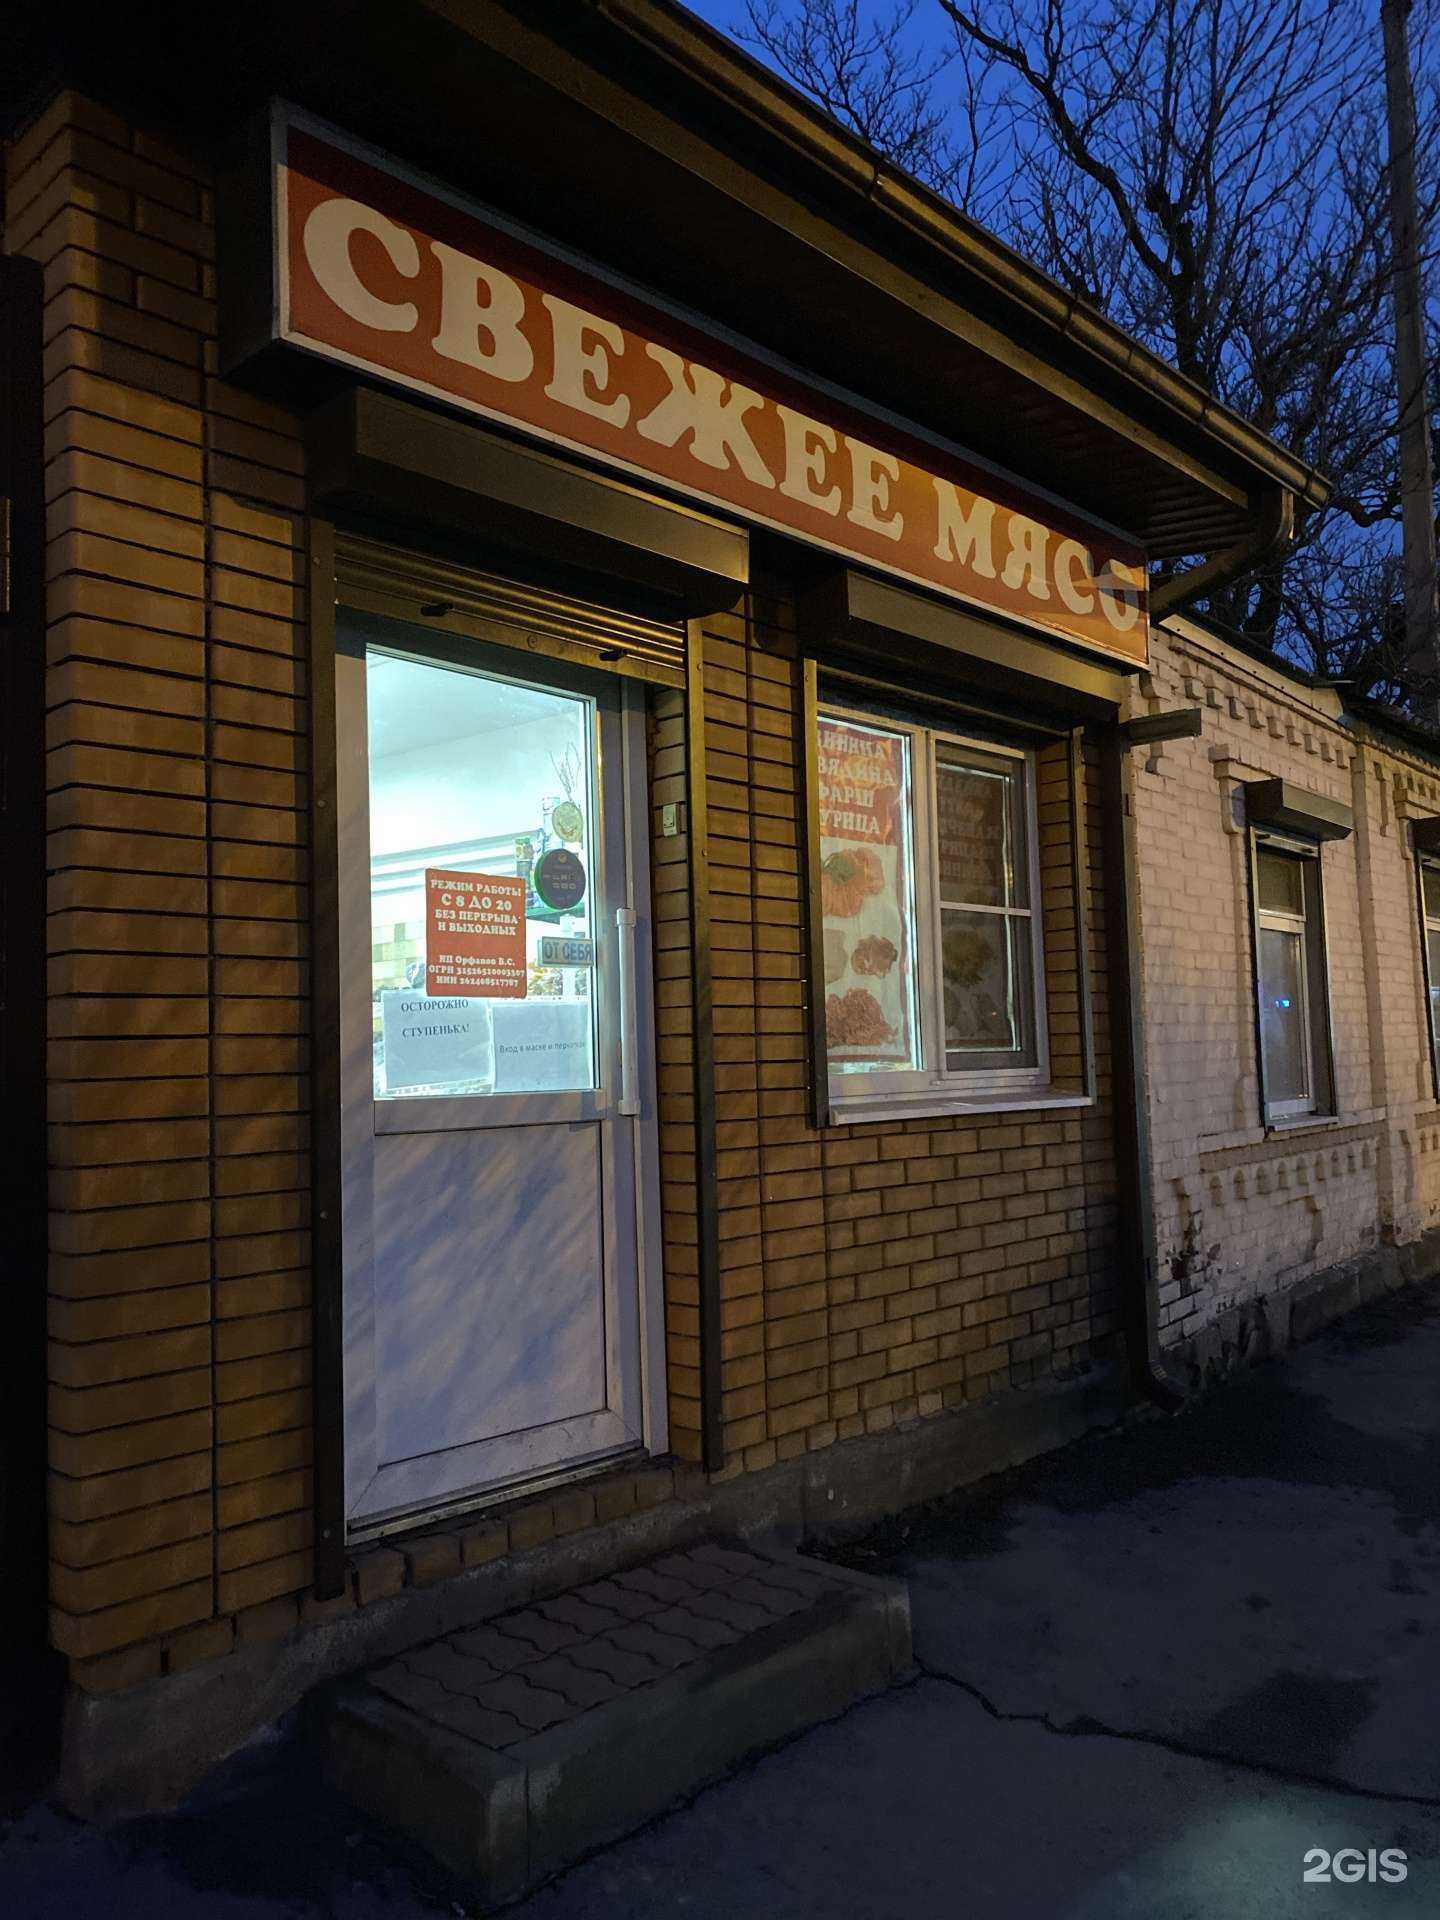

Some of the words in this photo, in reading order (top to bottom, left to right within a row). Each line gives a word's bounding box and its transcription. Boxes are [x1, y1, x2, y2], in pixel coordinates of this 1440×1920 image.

[302, 197, 905, 543] СВЕЖЕЕ
[932, 477, 1140, 632] МЯСО
[431, 879, 474, 892] РЕЖИМ
[476, 884, 522, 896] РАБОТЫ
[441, 893, 452, 906] С
[455, 896, 465, 907] 8
[469, 895, 492, 909] ДО
[496, 900, 512, 911] 20
[435, 909, 456, 919] БЕЗ
[459, 911, 518, 924] ПЕРЕРЫВА
[438, 921, 446, 931] И
[449, 922, 516, 935] ВЫХОДНЫХ
[544, 942, 559, 959] ОТ
[562, 943, 592, 961] СЕБЯ
[439, 955, 453, 963] ИП
[428, 965, 454, 974] ОГРН
[436, 976, 457, 984] ИНН
[401, 999, 469, 1012] ОСТОРОЖНО
[402, 1024, 470, 1037] СТУПЕНЬКА!
[499, 1045, 519, 1054] Вход
